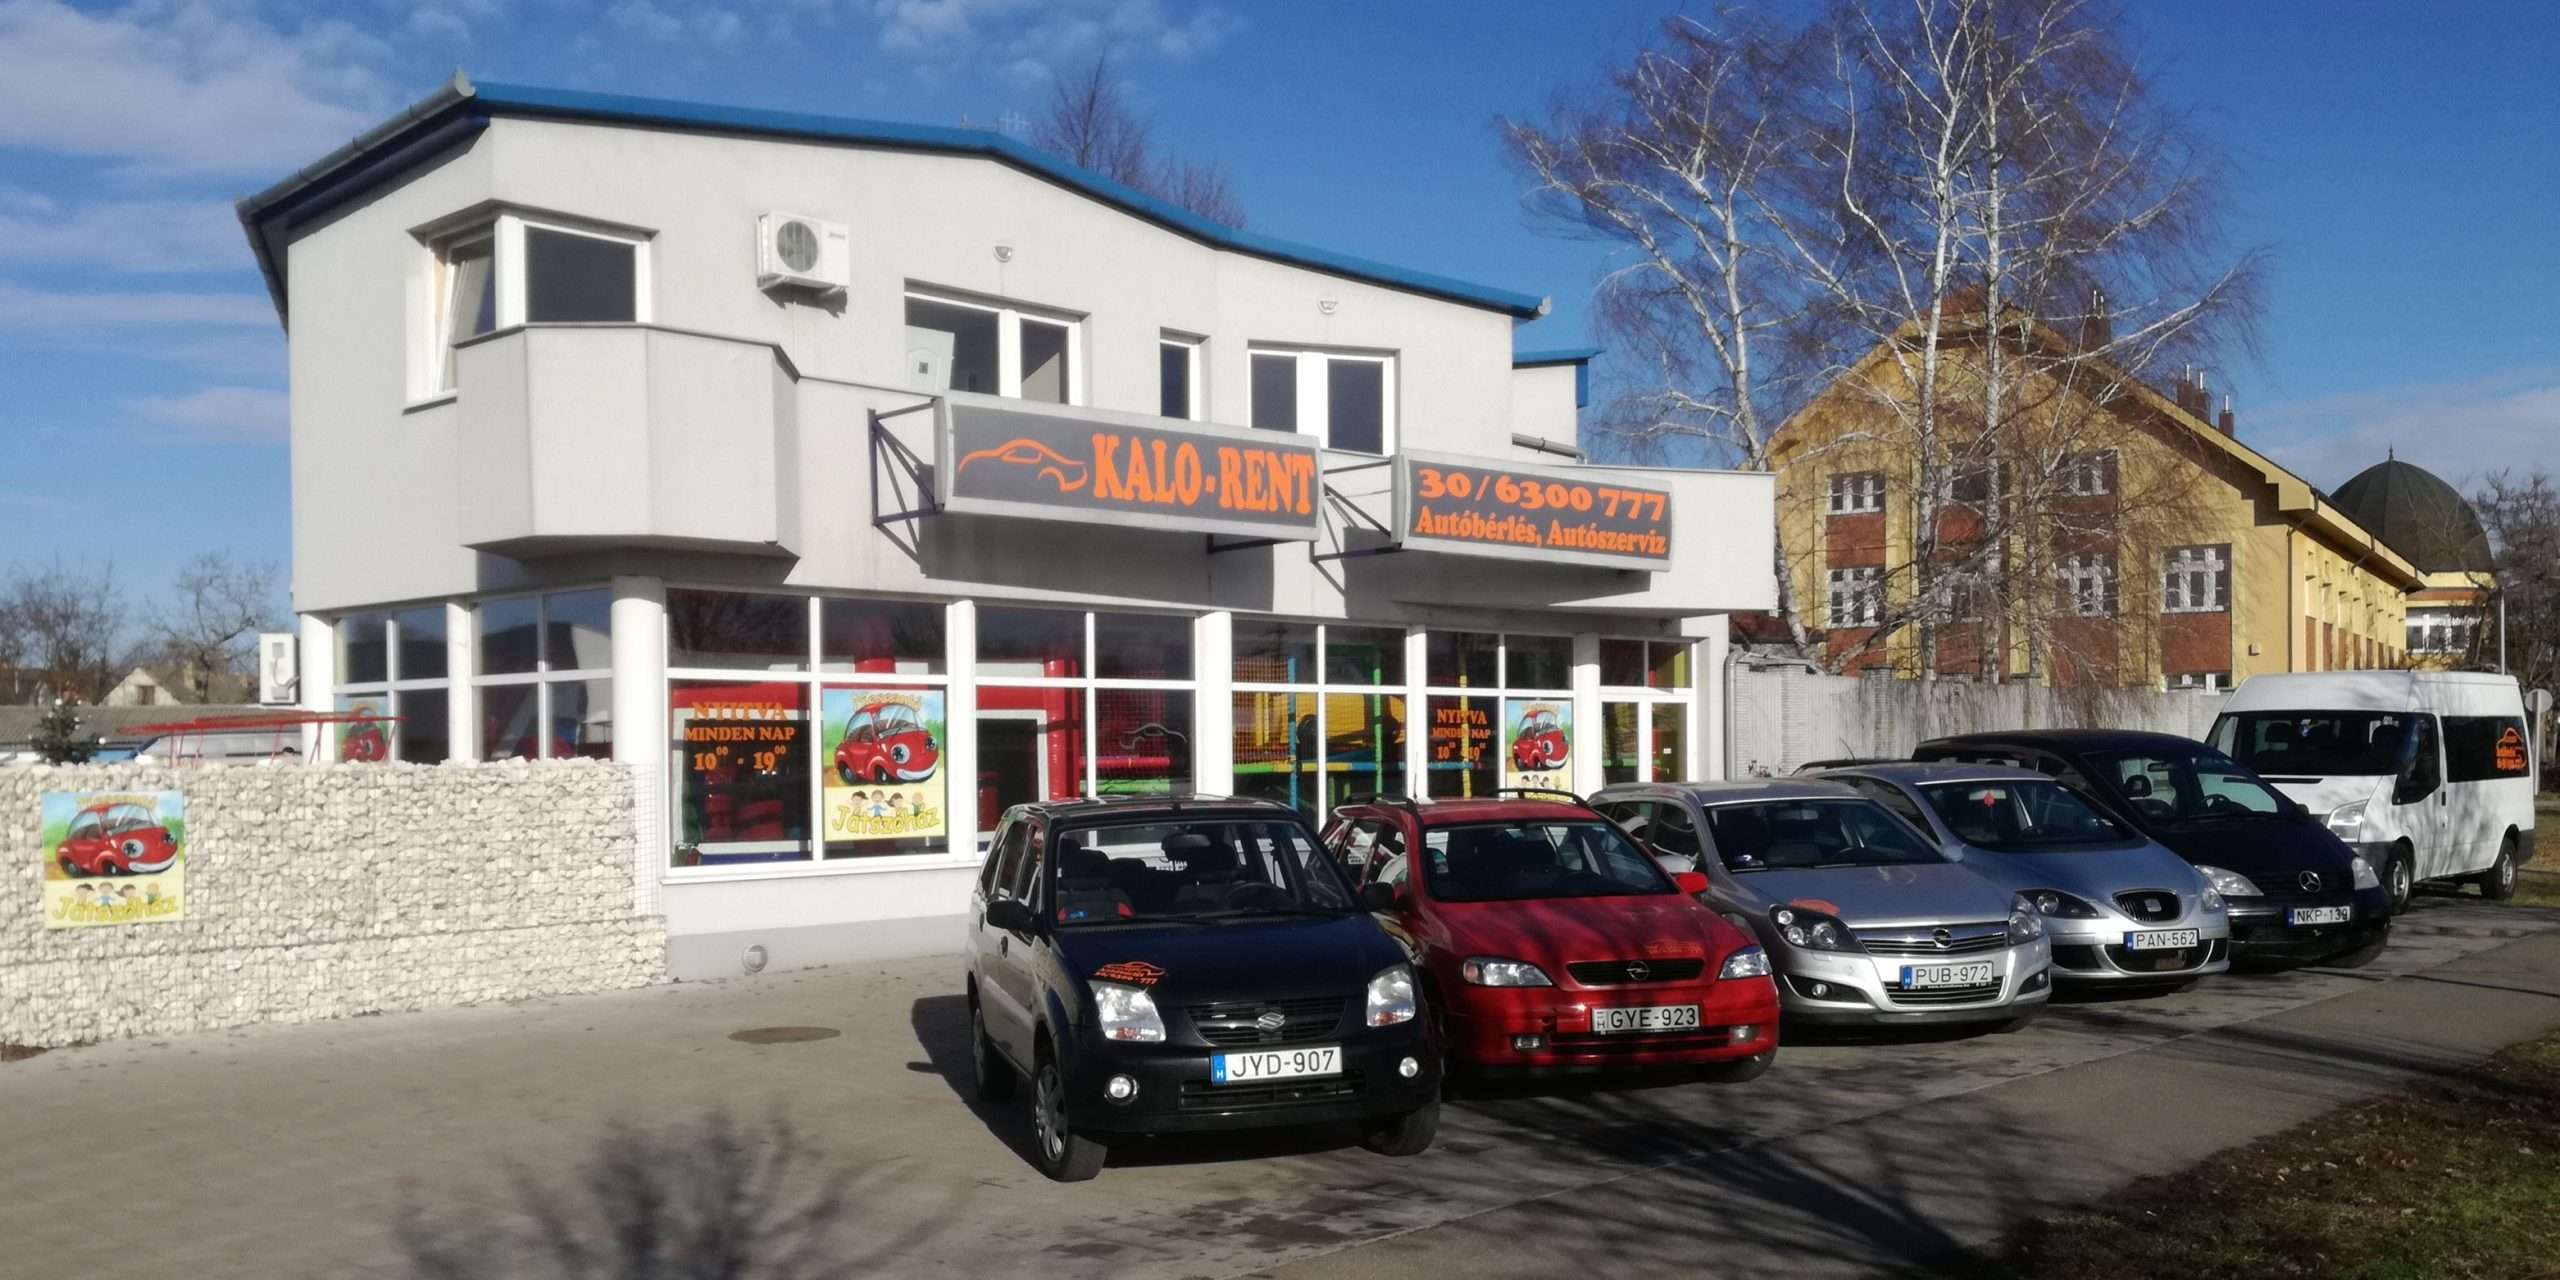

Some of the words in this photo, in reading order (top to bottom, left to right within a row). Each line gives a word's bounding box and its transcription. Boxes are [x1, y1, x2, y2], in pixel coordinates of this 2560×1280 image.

[1092, 433, 1316, 516] KALO-RENT
[1598, 488, 1666, 521] 777
[1415, 505, 1543, 548] Autóbérlés,
[1547, 519, 1667, 555] Autószerviz
[691, 702, 788, 721] NYITVA
[1436, 709, 1488, 725] NYITVA
[685, 727, 756, 741] MINDEN
[759, 726, 795, 741] NAP
[1471, 728, 1490, 739] NAP
[831, 804, 940, 834] Játszóház
[2136, 932, 2195, 947] PAN-562
[1916, 965, 1989, 984] PUB-972
[1611, 1008, 1696, 1028] GYE-923
[1232, 1049, 1334, 1078] JYD-907
